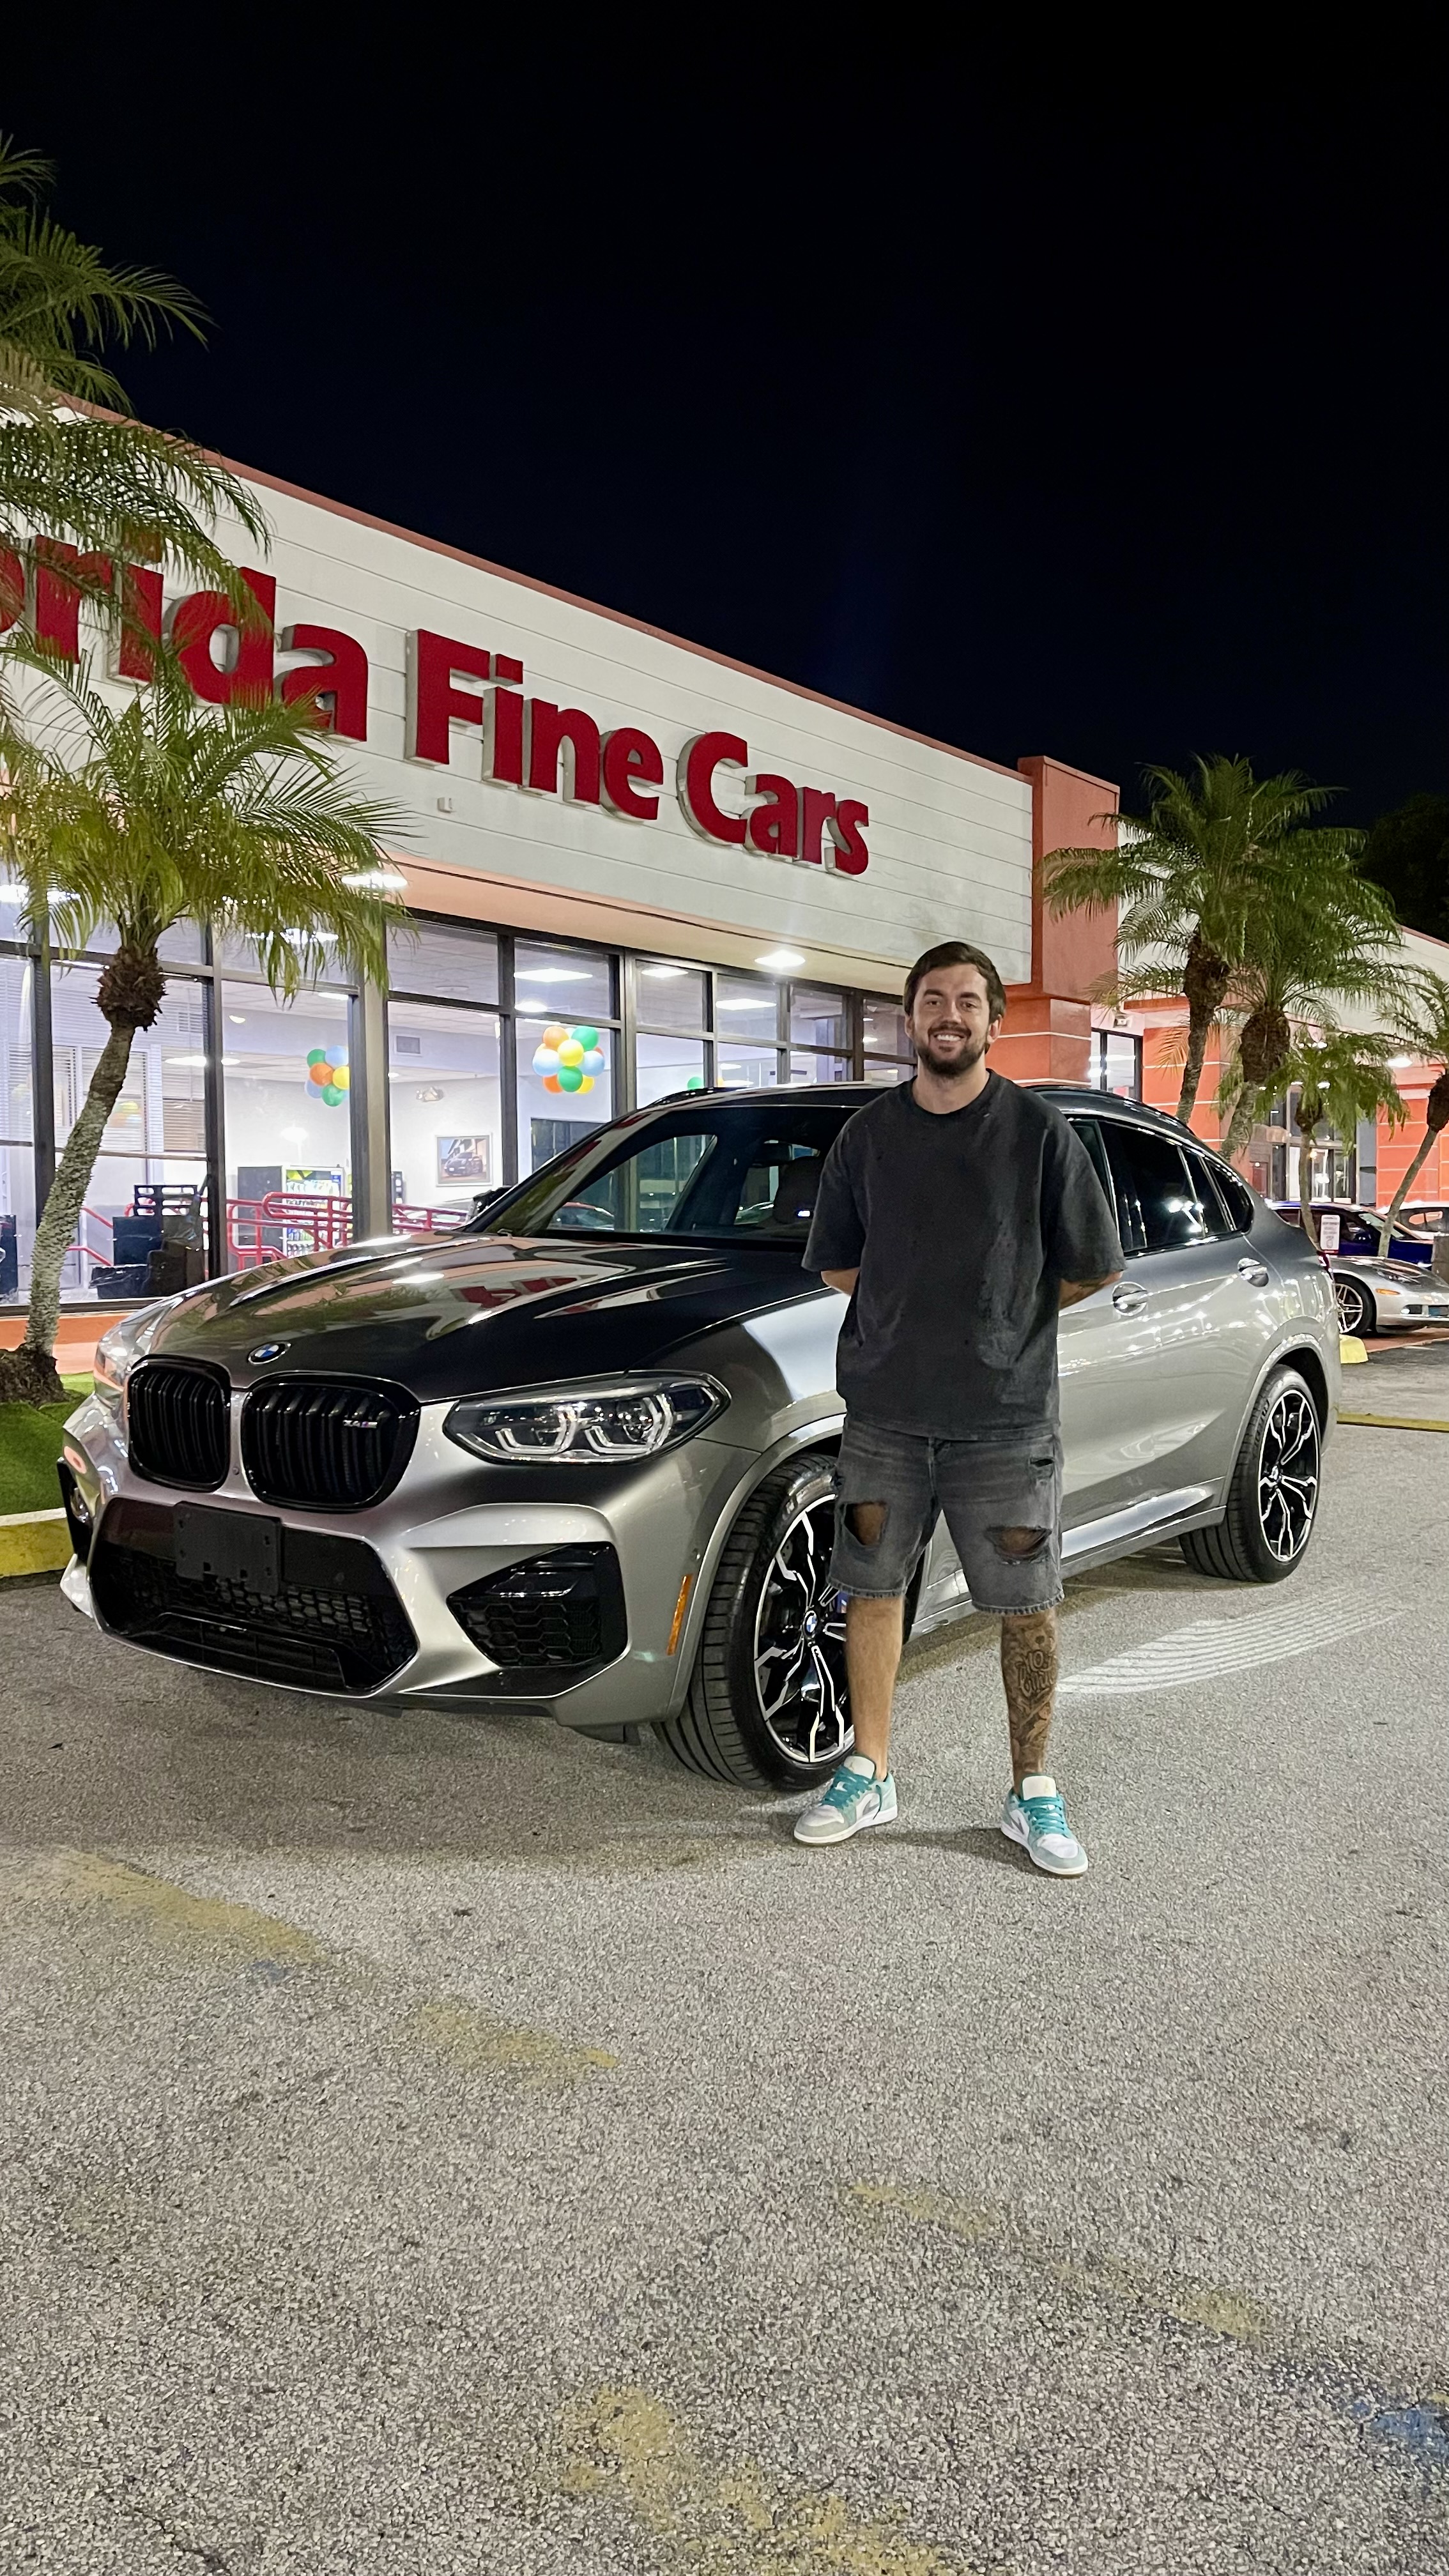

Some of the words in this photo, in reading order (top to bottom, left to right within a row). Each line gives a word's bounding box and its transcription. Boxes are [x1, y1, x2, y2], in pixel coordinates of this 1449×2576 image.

[0, 526, 368, 742] rida
[417, 629, 663, 820] Fine
[687, 732, 869, 875] Cars
